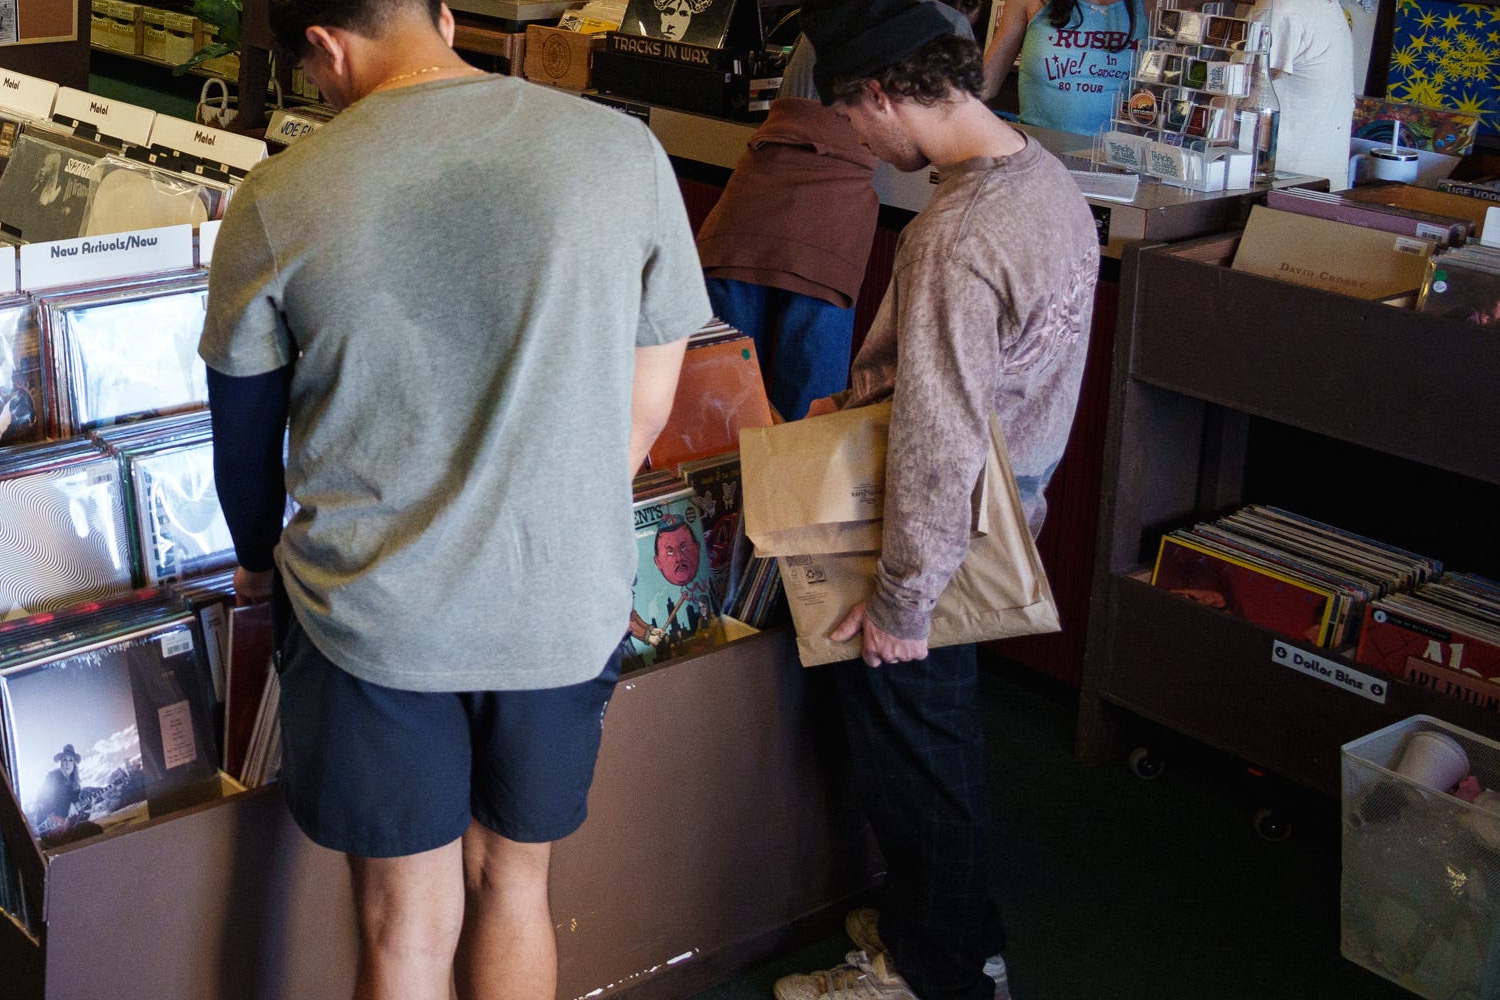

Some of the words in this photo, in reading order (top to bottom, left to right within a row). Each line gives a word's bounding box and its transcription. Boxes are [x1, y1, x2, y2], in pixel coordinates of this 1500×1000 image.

[1054, 29, 1128, 50] RUSH
[612, 36, 661, 56] TRACKS
[664, 42, 677, 59] IN
[680, 46, 710, 65] WAX
[1044, 52, 1087, 81] Live!
[1106, 54, 1118, 66] in
[3, 76, 20, 90] Metal
[1058, 82, 1071, 91] 80
[1076, 82, 1104, 94] TOUR
[90, 101, 109, 116] Metal
[194, 129, 216, 147] Metal
[51, 244, 78, 258] New
[80, 234, 159, 256] Arrivals/New
[1279, 261, 1315, 278] DAVID
[1293, 653, 1333, 678] Dollar
